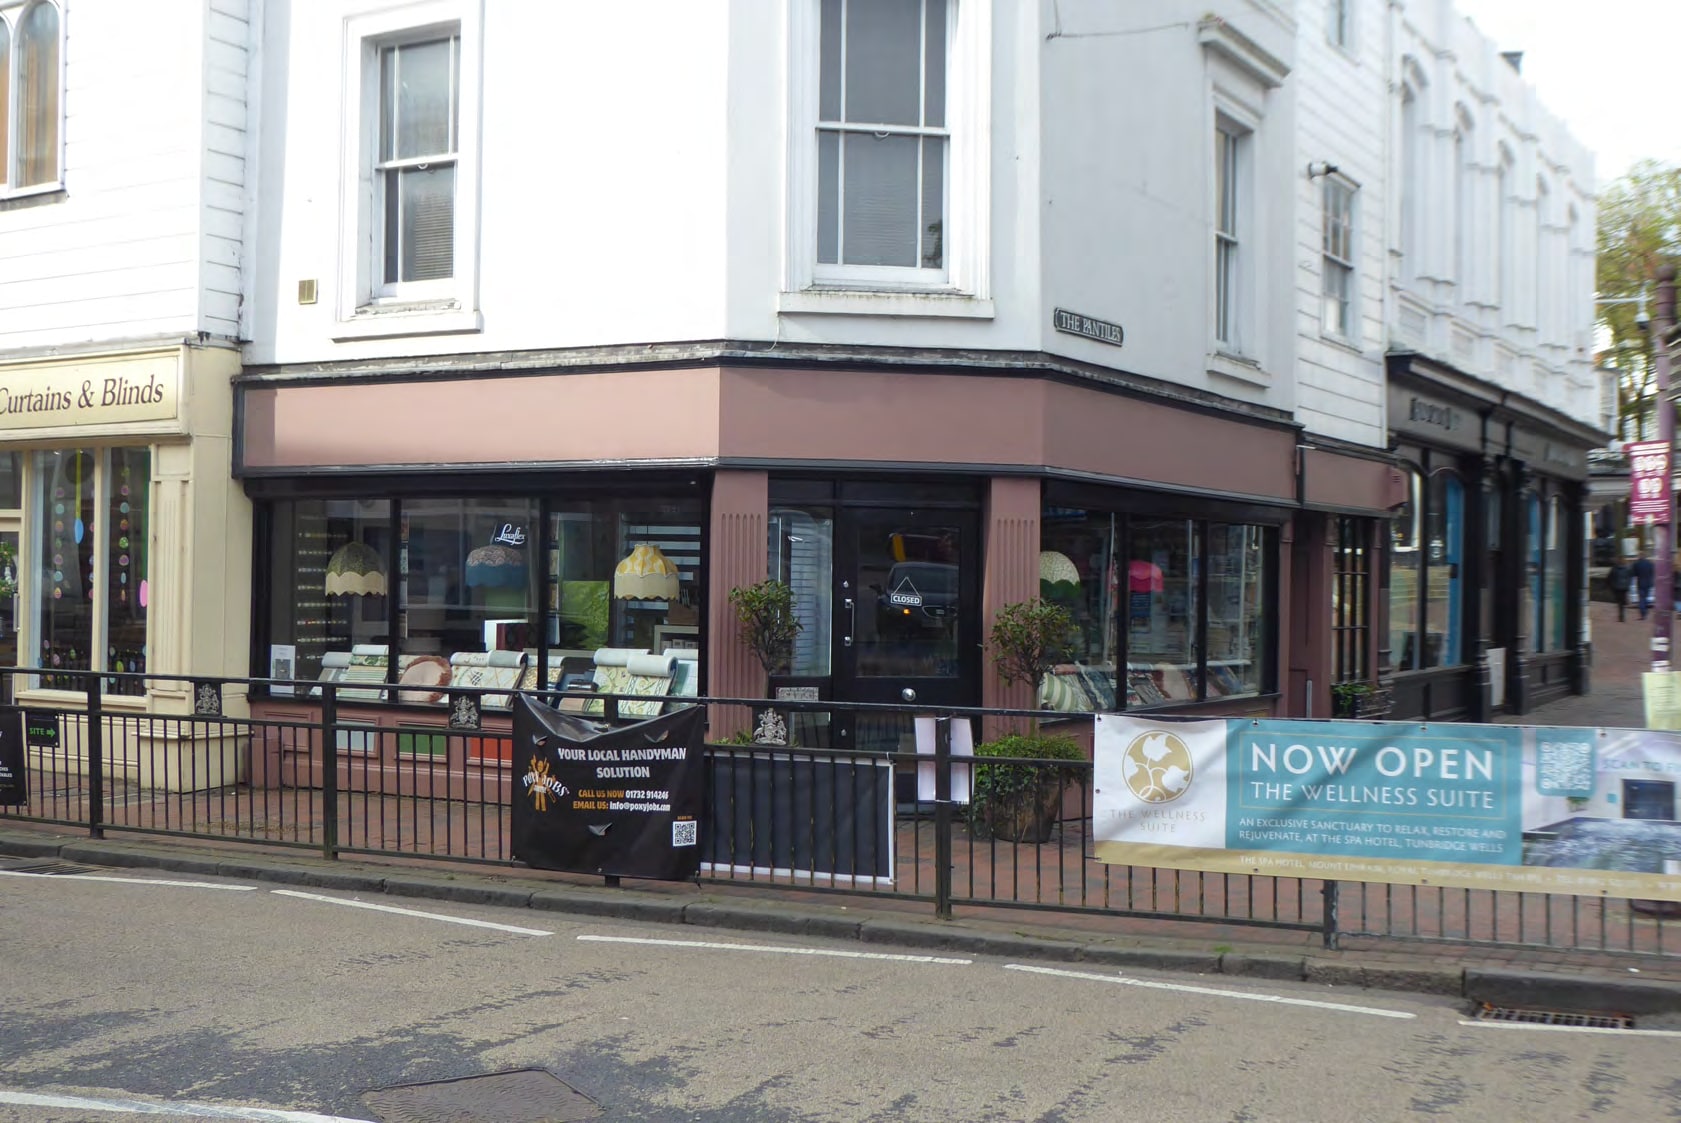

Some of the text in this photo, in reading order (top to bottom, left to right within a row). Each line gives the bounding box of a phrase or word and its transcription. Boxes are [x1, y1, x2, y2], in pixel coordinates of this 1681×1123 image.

[1060, 312, 1121, 342] THE PANTILES
[0, 374, 164, 416] Curtains & Blinds
[893, 595, 920, 604] CLOSED
[29, 727, 45, 736] SITE
[558, 748, 687, 761] YOUR LOCAL HANDYMAN
[1251, 742, 1494, 781] NOW OPEN
[596, 766, 650, 778] SOLUTION
[578, 789, 595, 798] CALL
[596, 790, 606, 798] US
[607, 790, 625, 798] NOW
[625, 790, 645, 799] 01732
[1250, 781, 1494, 809] THE WELLNESS SUITE
[572, 801, 596, 810] EMAIL
[597, 801, 609, 810] US:
[1110, 809, 1208, 822] THE WELLNESS
[1139, 822, 1176, 833] SUITE
[1239, 818, 1254, 827] AN
[1256, 818, 1309, 829] EXCLUSIVE
[1311, 820, 1374, 832] SANCTUARY
[1376, 823, 1393, 834] TO
[1432, 826, 1481, 838] RESTORE
[1482, 829, 1507, 840] AND
[1305, 833, 1318, 843] AT
[1321, 834, 1342, 844] THE
[1344, 835, 1363, 845] SPA
[1403, 838, 1468, 851] TUNBRIDGE
[1470, 842, 1504, 853] WELLS
